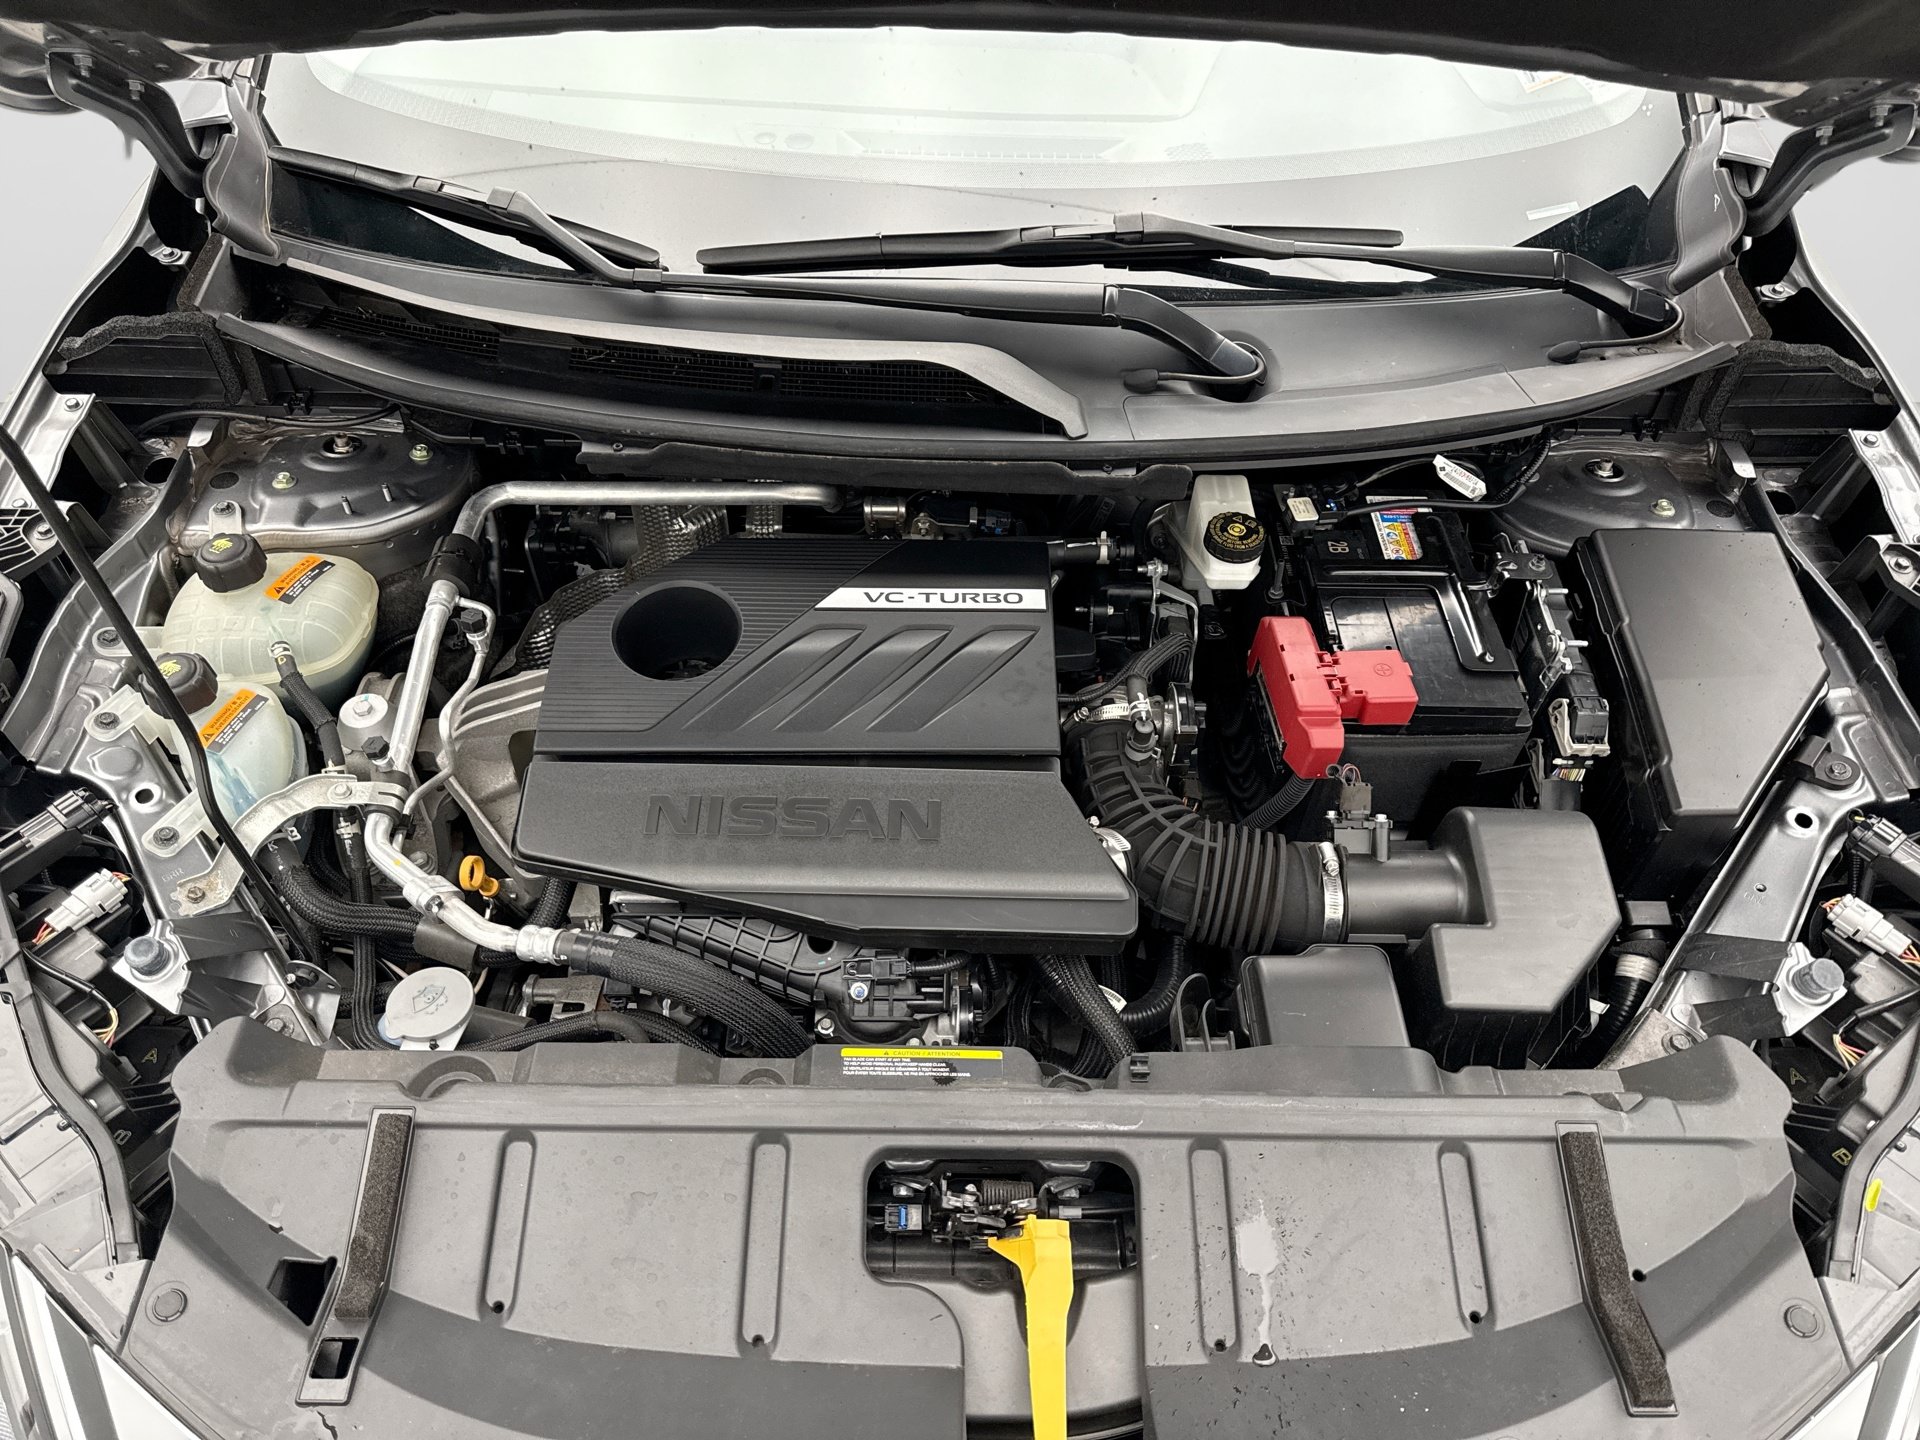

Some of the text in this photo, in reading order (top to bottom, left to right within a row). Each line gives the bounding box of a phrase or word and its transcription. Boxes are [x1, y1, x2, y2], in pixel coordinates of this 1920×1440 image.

[1327, 541, 1350, 553] 2B
[863, 591, 1024, 604] VC-TURBO
[643, 795, 941, 841] NISSAN
[141, 1048, 157, 1064] A
[1790, 1067, 1807, 1085] A
[1831, 1147, 1853, 1166] B
